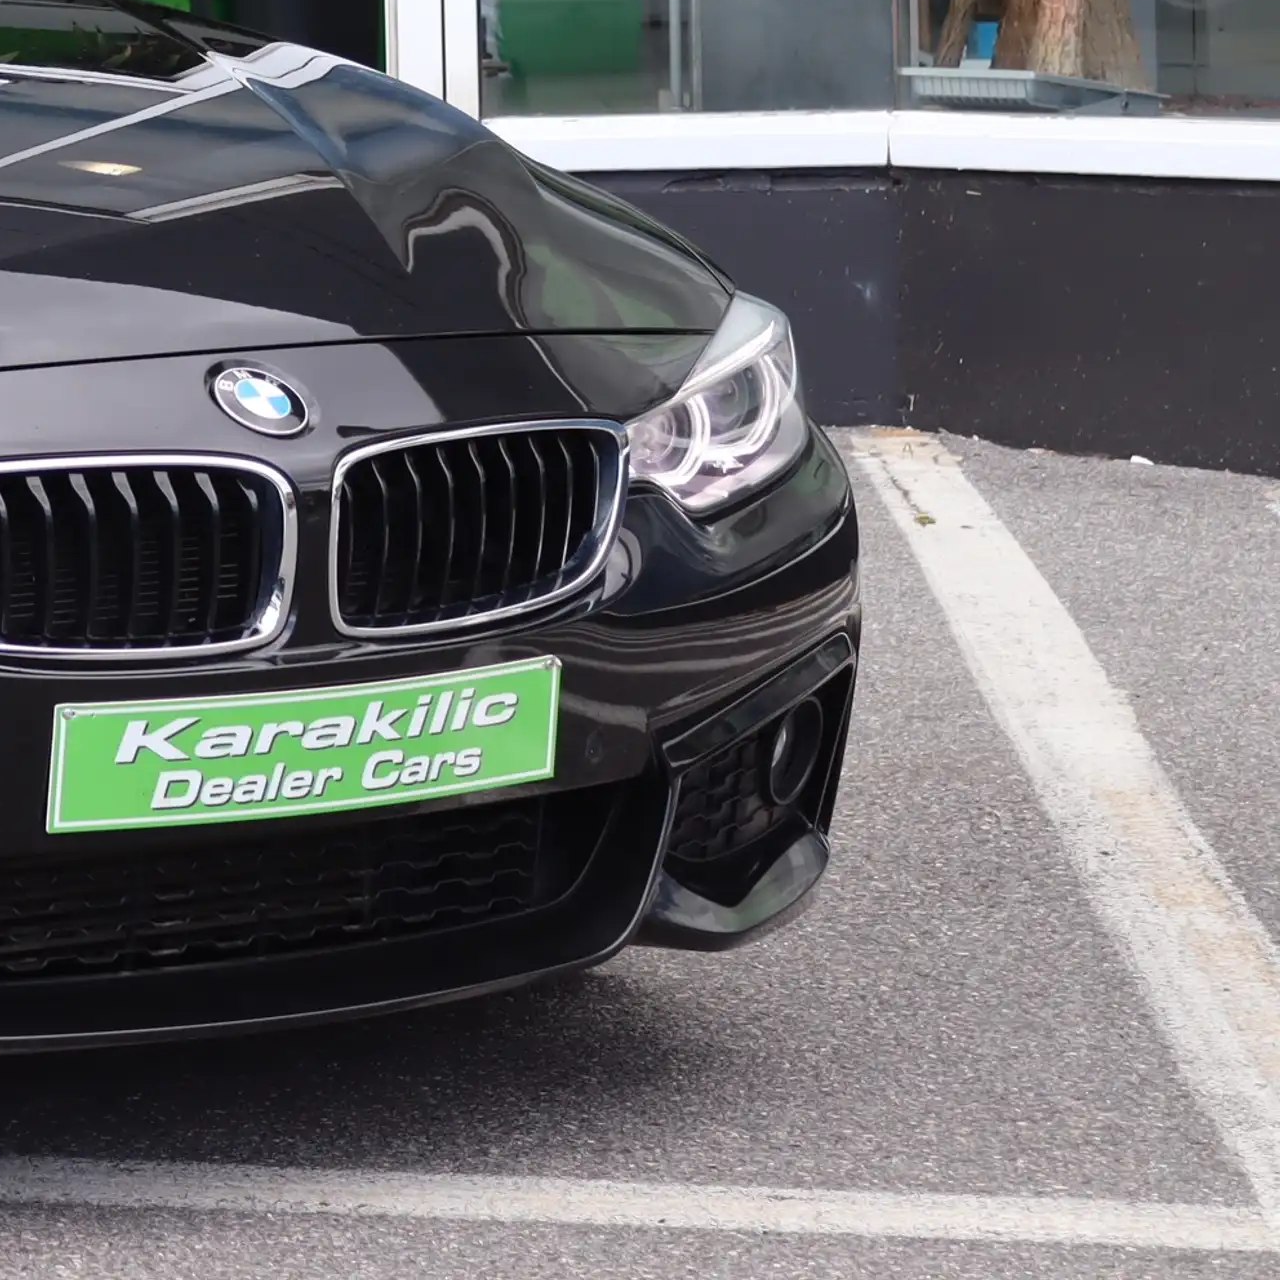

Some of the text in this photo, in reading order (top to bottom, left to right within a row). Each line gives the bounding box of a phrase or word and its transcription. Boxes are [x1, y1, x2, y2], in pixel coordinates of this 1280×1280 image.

[114, 687, 519, 765] Karakilic
[150, 746, 484, 811] Dealer Cars
